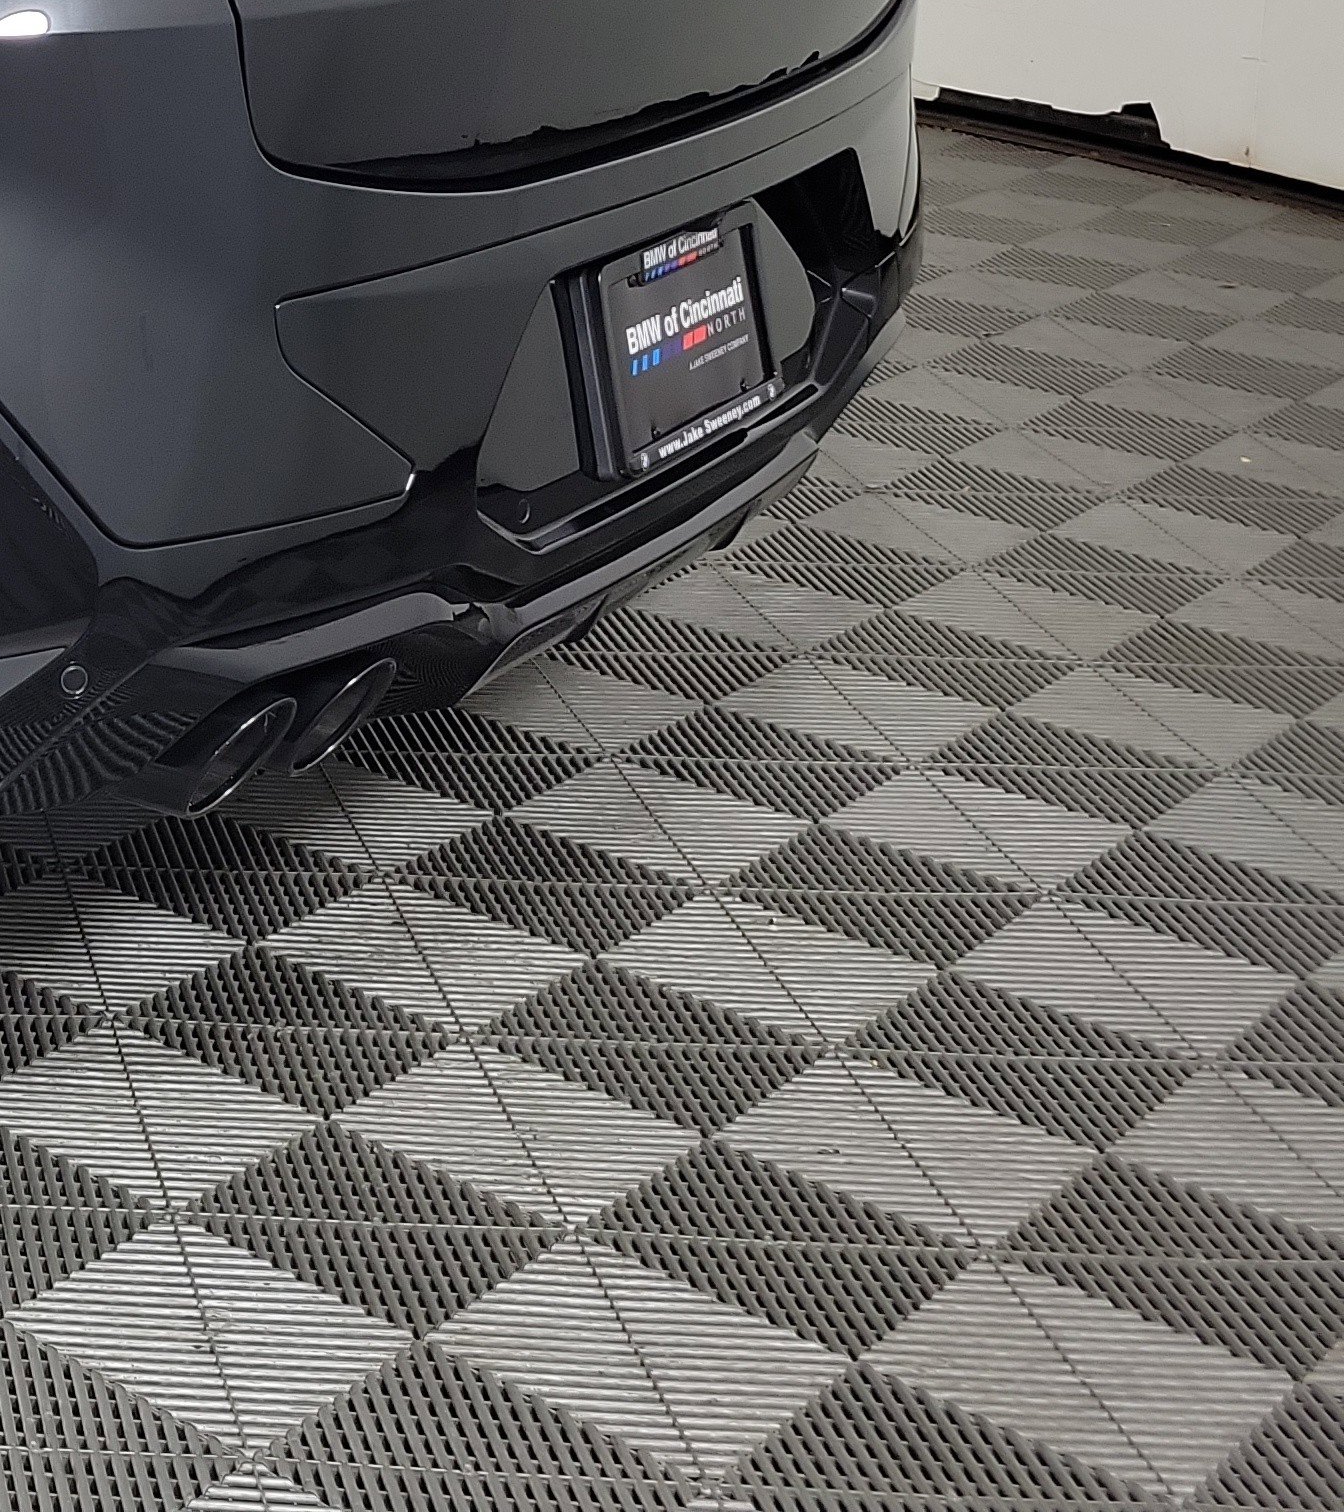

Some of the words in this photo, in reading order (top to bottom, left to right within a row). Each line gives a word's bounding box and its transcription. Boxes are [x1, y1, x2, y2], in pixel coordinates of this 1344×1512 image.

[643, 244, 666, 270] BMW
[626, 314, 662, 355] BMW
[664, 306, 679, 337] of
[679, 276, 744, 329] Cincinnati
[707, 307, 746, 337] NORTH
[704, 344, 727, 362] SWEENEY
